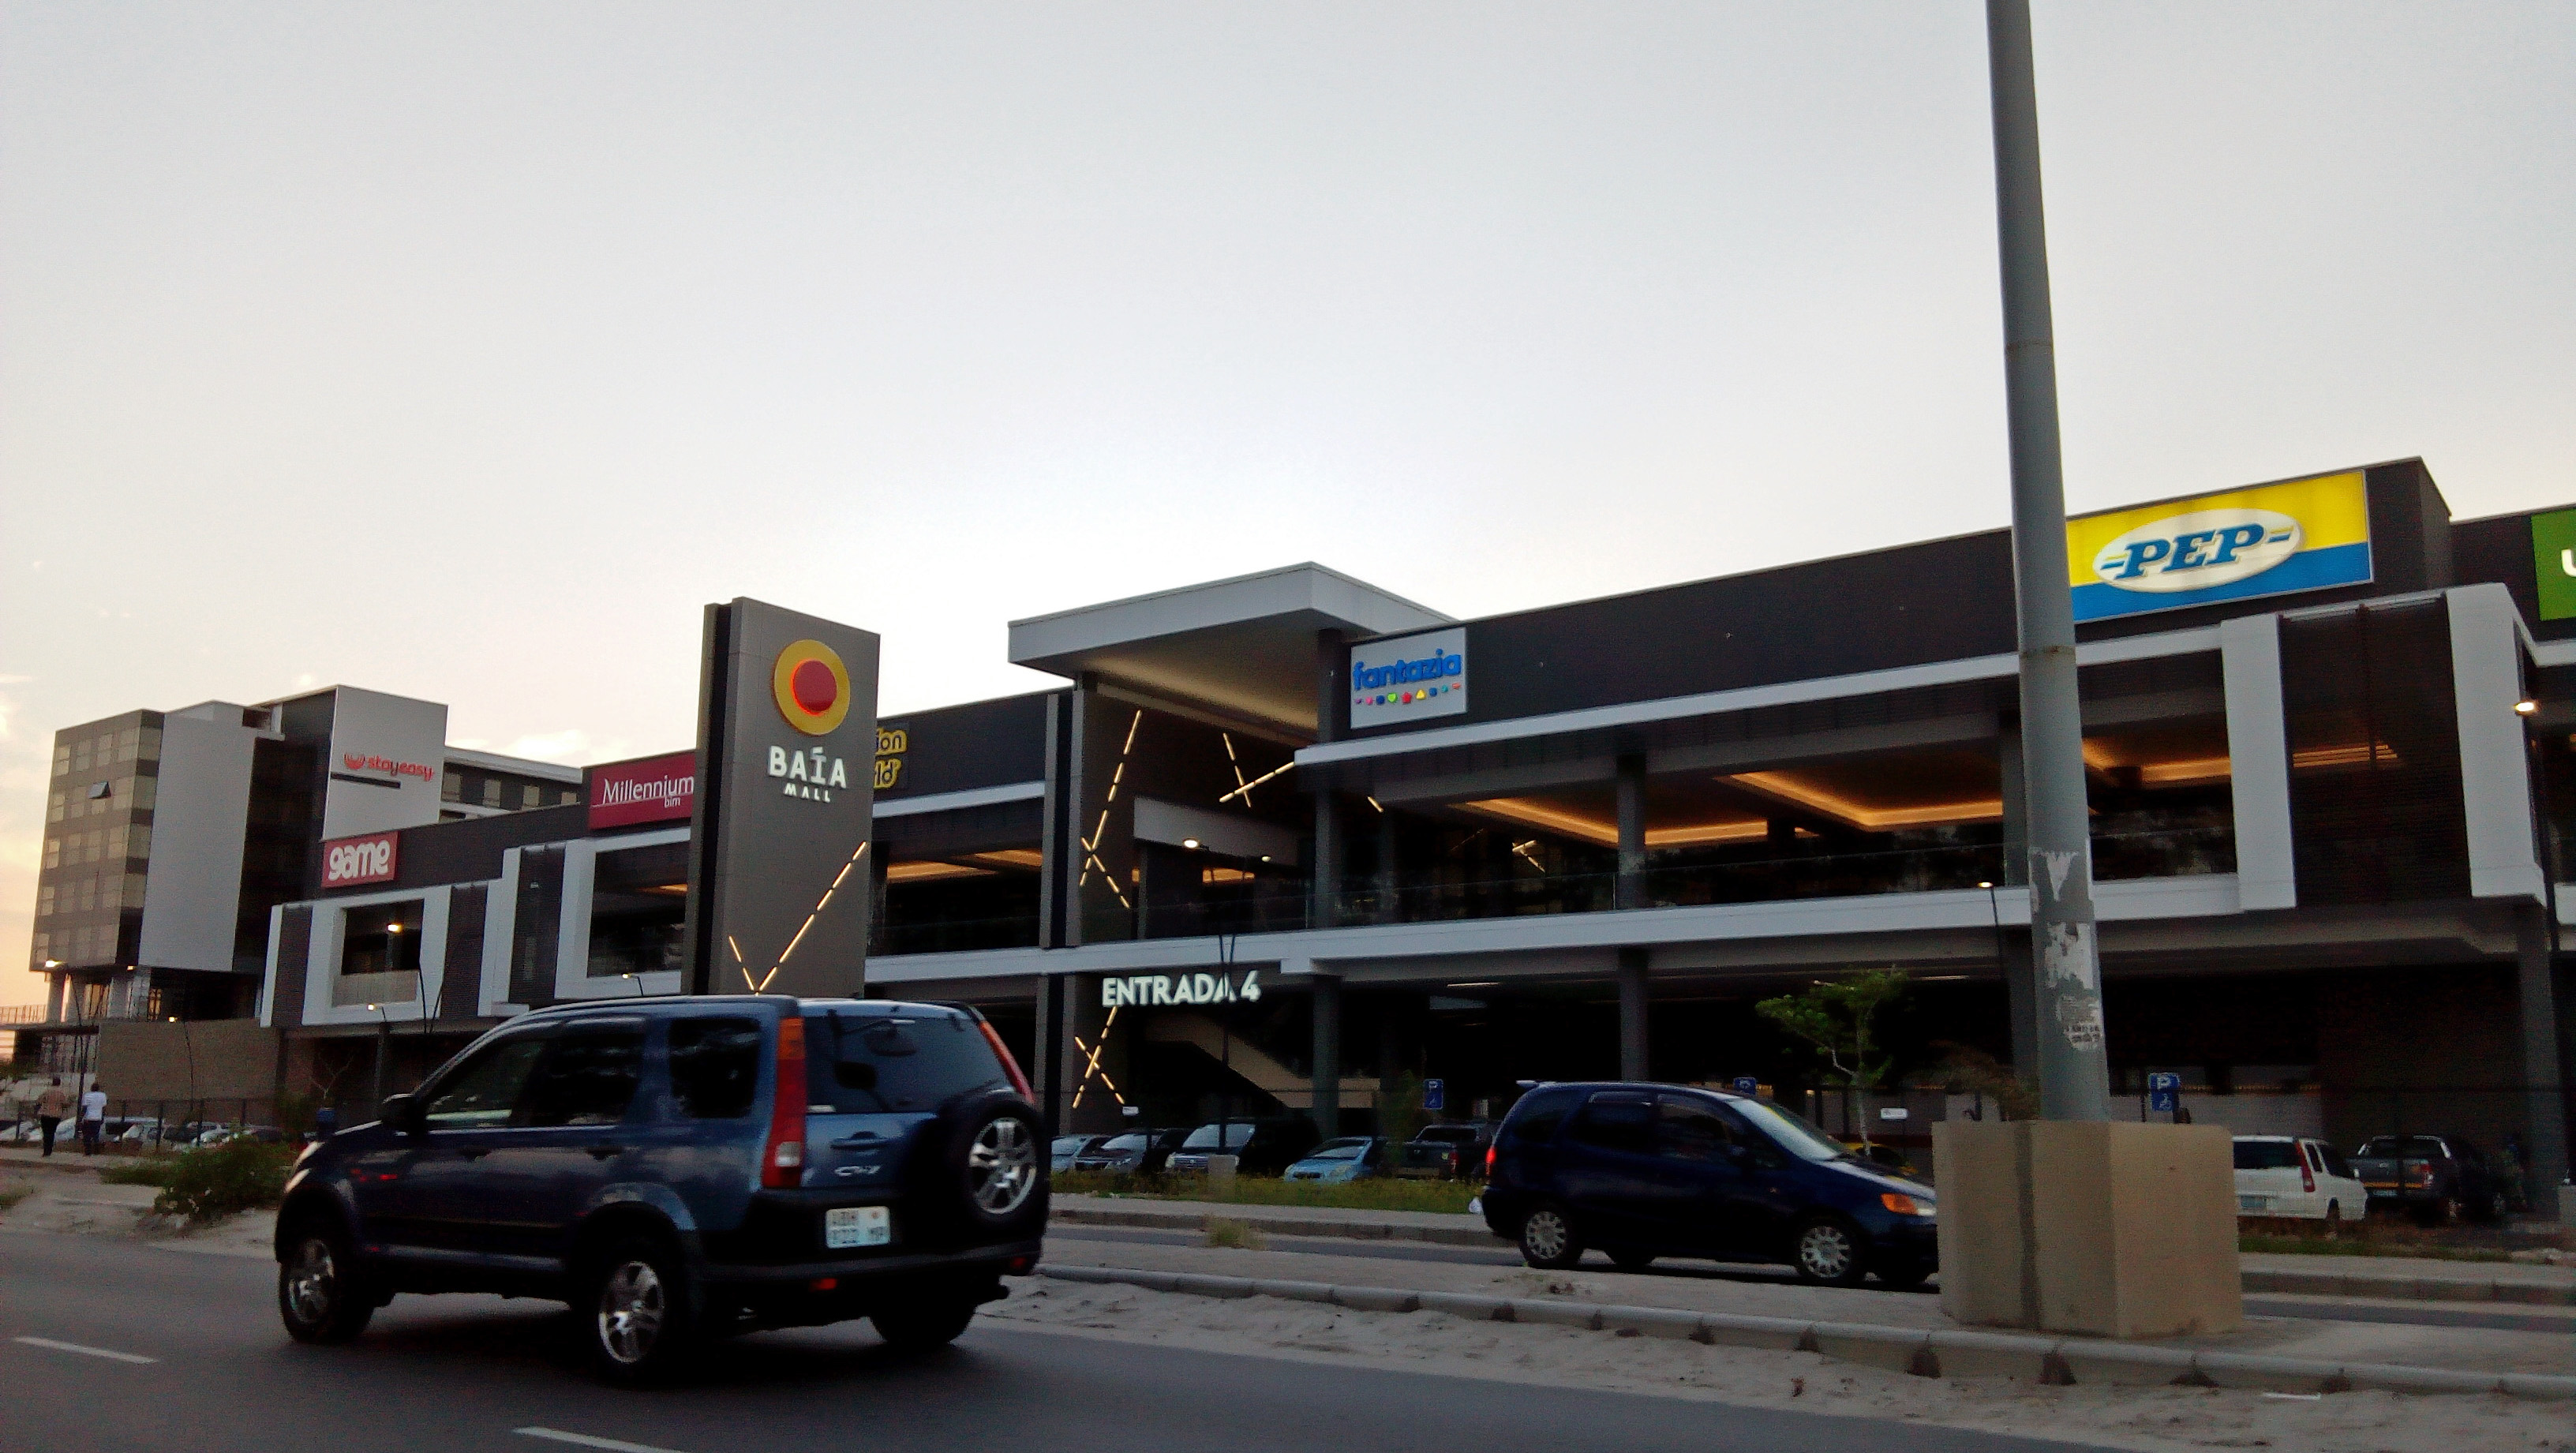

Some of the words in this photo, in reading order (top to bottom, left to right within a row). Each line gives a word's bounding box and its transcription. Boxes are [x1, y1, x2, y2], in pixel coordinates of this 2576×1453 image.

[2114, 522, 2264, 580] PEP
[1353, 648, 1462, 691] fantazia
[367, 755, 433, 781] stayeasy
[602, 774, 695, 805] Millennium
[664, 796, 681, 808] bim
[784, 782, 831, 803] MALL
[328, 840, 391, 882] game
[1102, 972, 1237, 1008] ENTRADA
[1241, 970, 1262, 1002] 4
